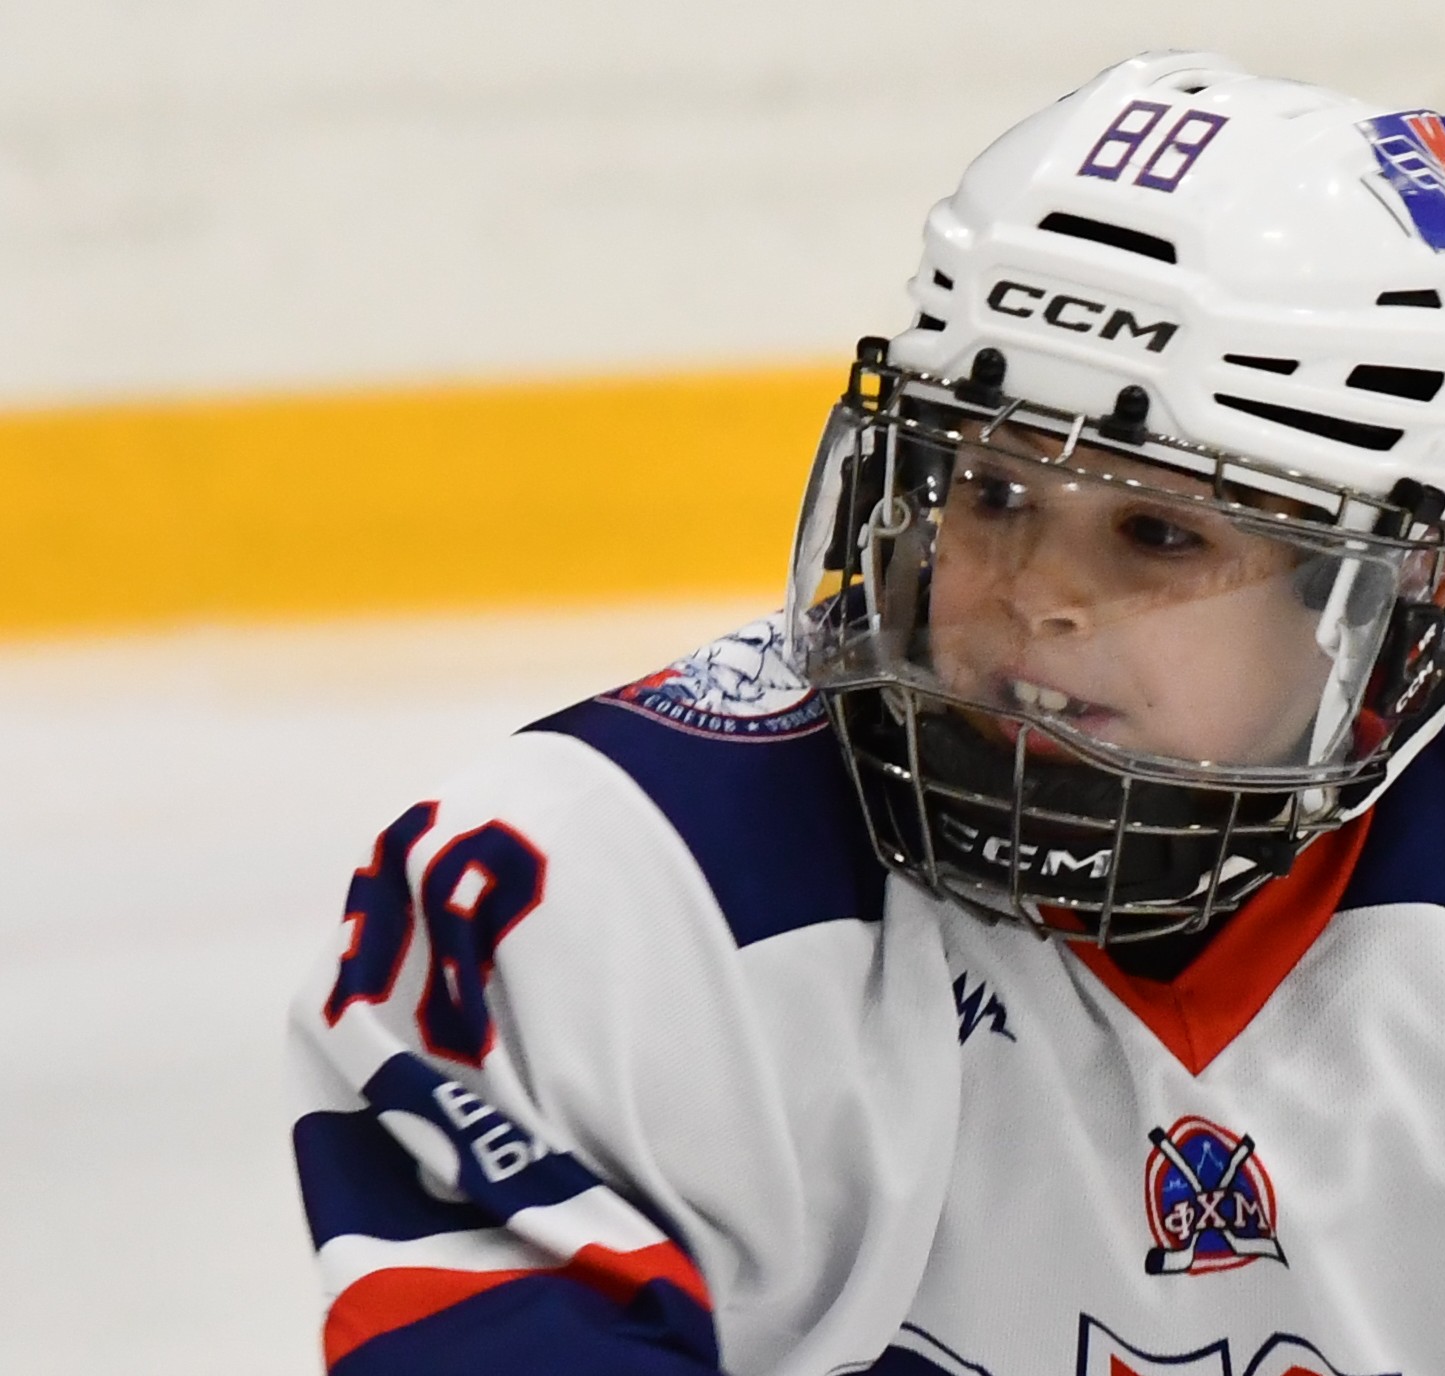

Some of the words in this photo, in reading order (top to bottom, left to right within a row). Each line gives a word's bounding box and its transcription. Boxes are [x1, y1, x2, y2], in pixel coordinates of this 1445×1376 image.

[1076, 100, 1230, 193] 88
[986, 279, 1180, 353] CCM
[938, 811, 1115, 879] CCM
[1164, 1191, 1270, 1241] ФХМ
